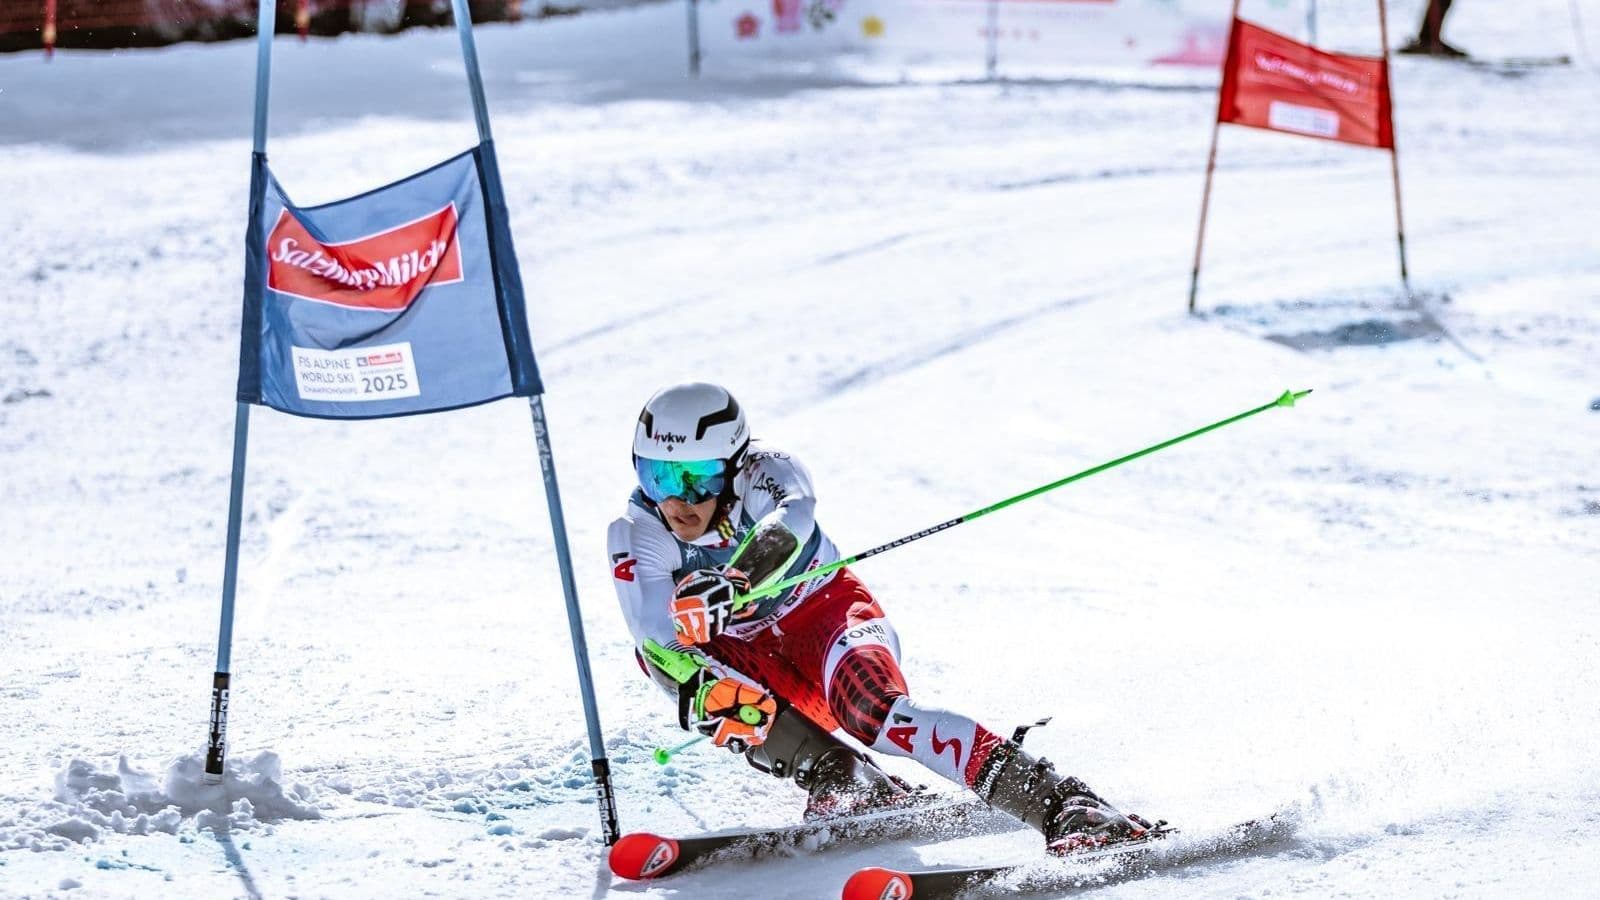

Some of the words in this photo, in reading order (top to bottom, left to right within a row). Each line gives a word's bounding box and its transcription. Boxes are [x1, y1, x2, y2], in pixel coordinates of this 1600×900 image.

[298, 356, 311, 369] FIS
[313, 358, 352, 370] ALPINE
[302, 371, 334, 384] WORLD
[336, 373, 355, 384] SKI
[361, 373, 408, 394] 2025
[660, 431, 687, 444] vkw
[611, 551, 638, 582] A1
[886, 712, 919, 754] A1
